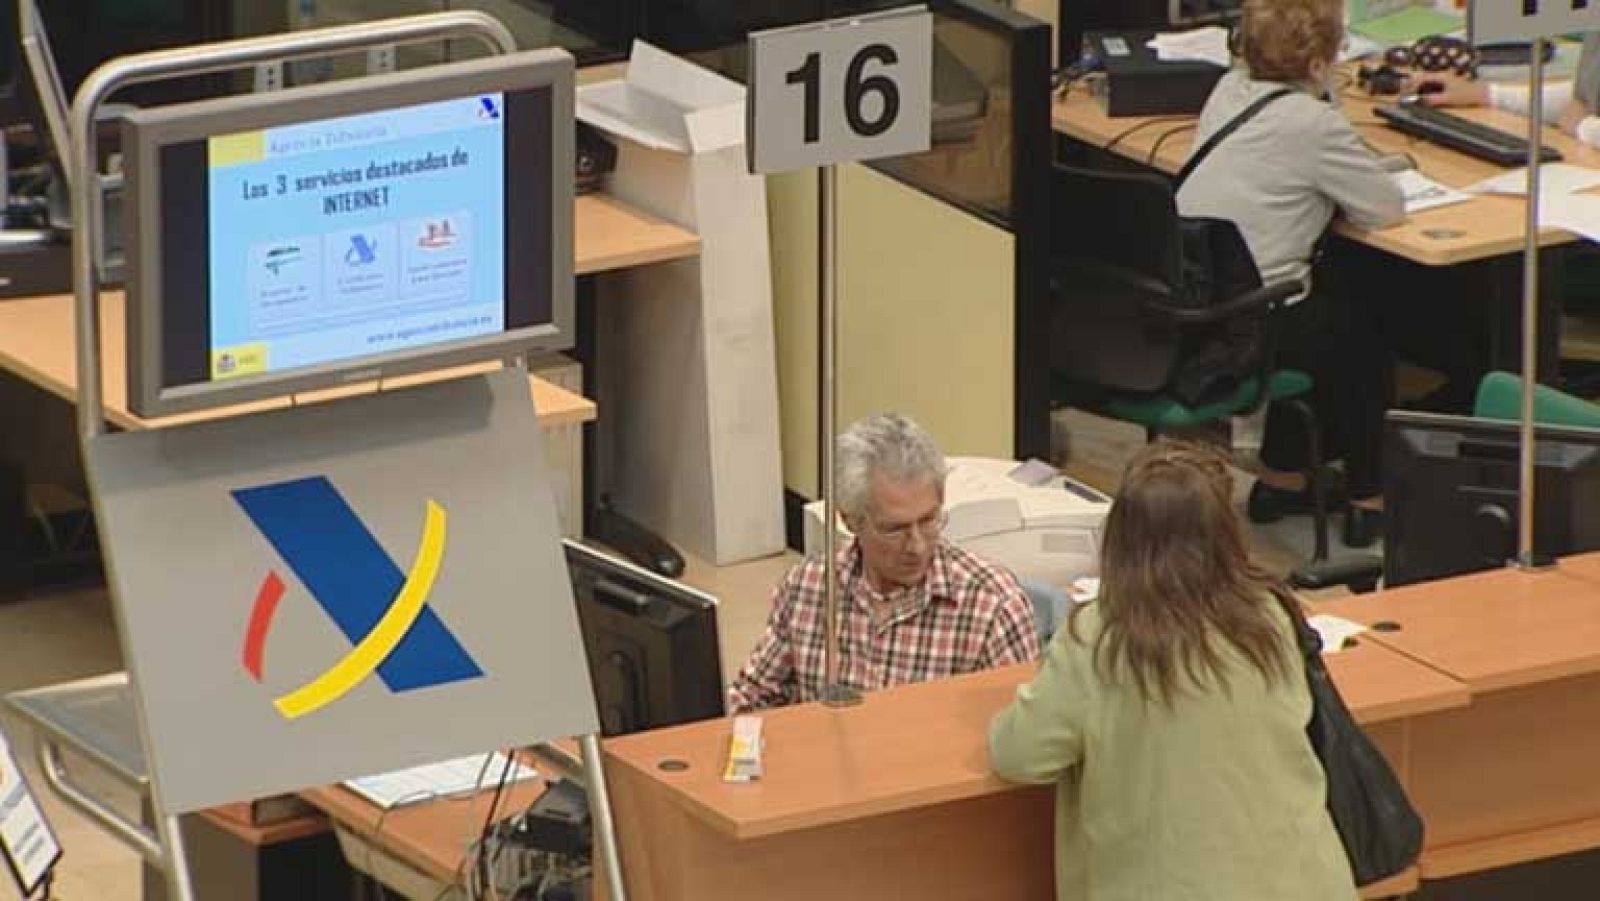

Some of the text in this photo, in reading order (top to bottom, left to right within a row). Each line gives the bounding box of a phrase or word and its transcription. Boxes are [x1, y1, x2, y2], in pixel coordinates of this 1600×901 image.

[786, 43, 899, 144] 16
[276, 174, 287, 194] 3
[296, 168, 363, 192] servicios
[366, 152, 449, 179] destacados
[451, 147, 469, 167] de
[323, 186, 388, 214] INTERNET
